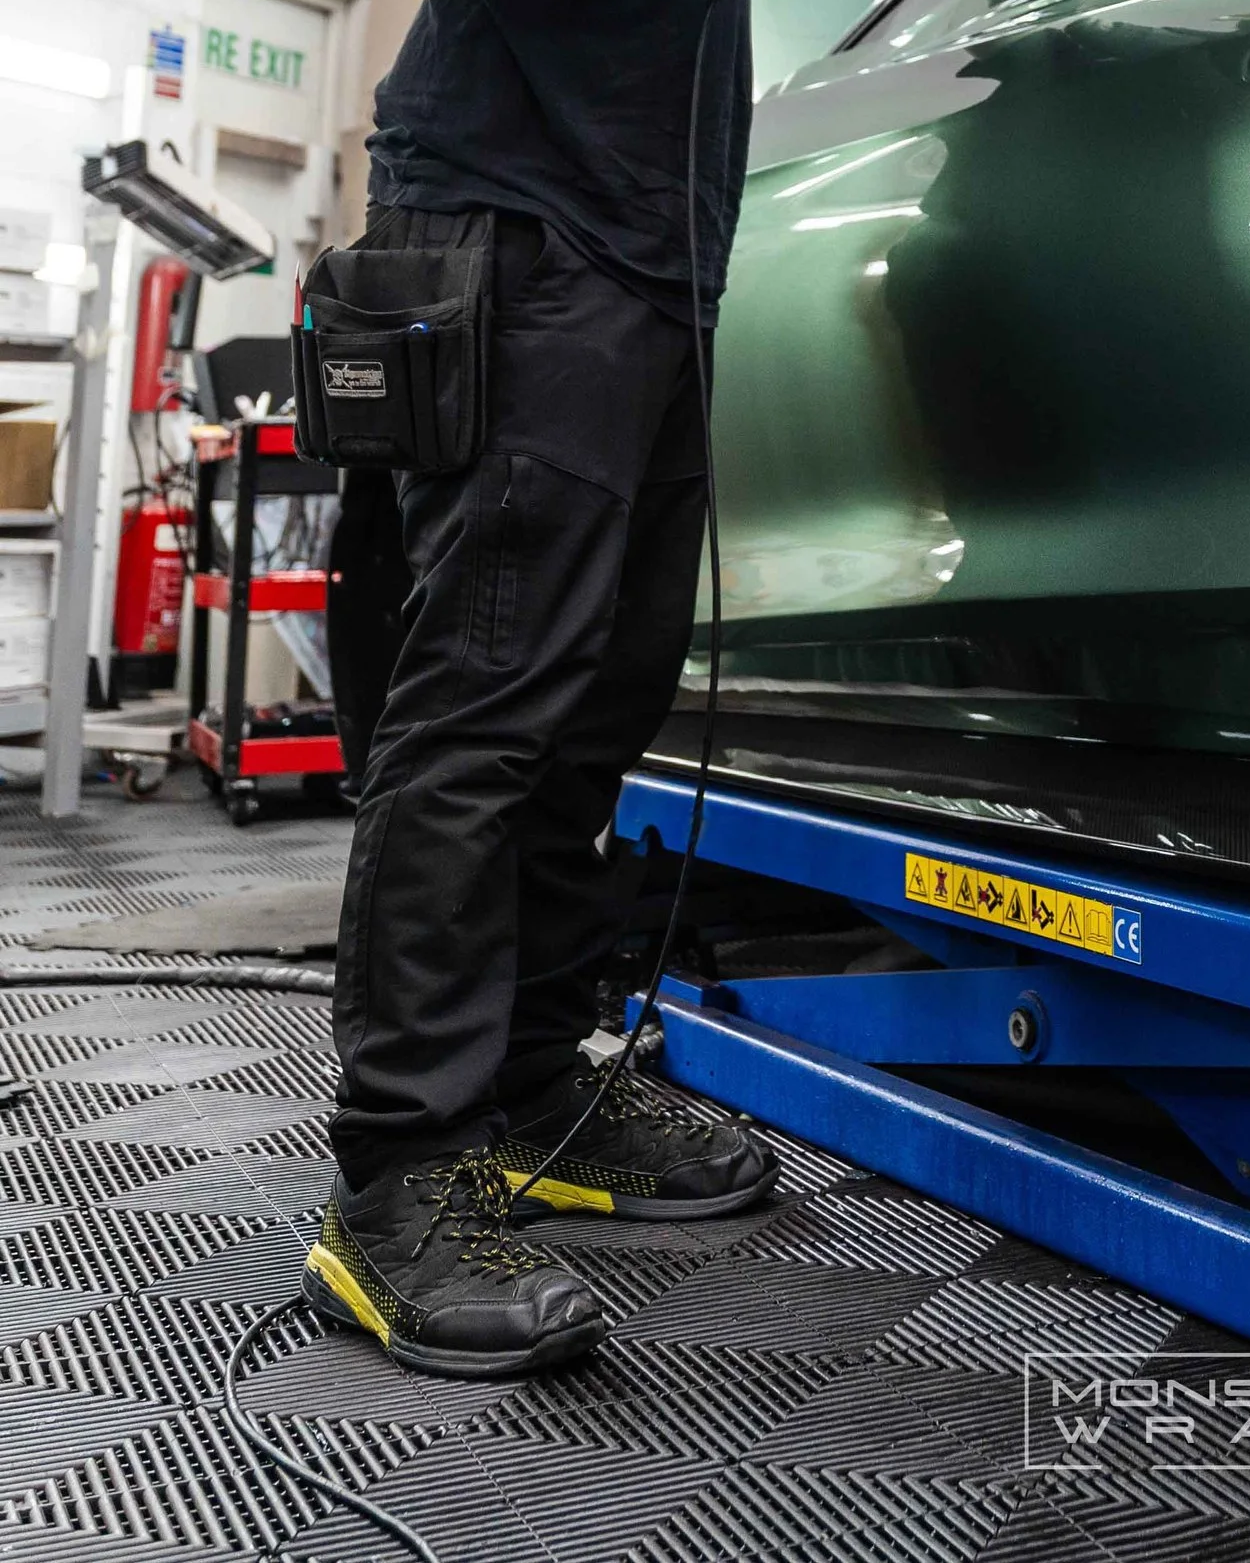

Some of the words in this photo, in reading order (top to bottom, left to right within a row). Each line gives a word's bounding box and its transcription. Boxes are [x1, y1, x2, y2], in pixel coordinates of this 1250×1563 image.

[203, 27, 239, 74] RE
[250, 38, 305, 88] EXIT
[1115, 918, 1139, 954] CE
